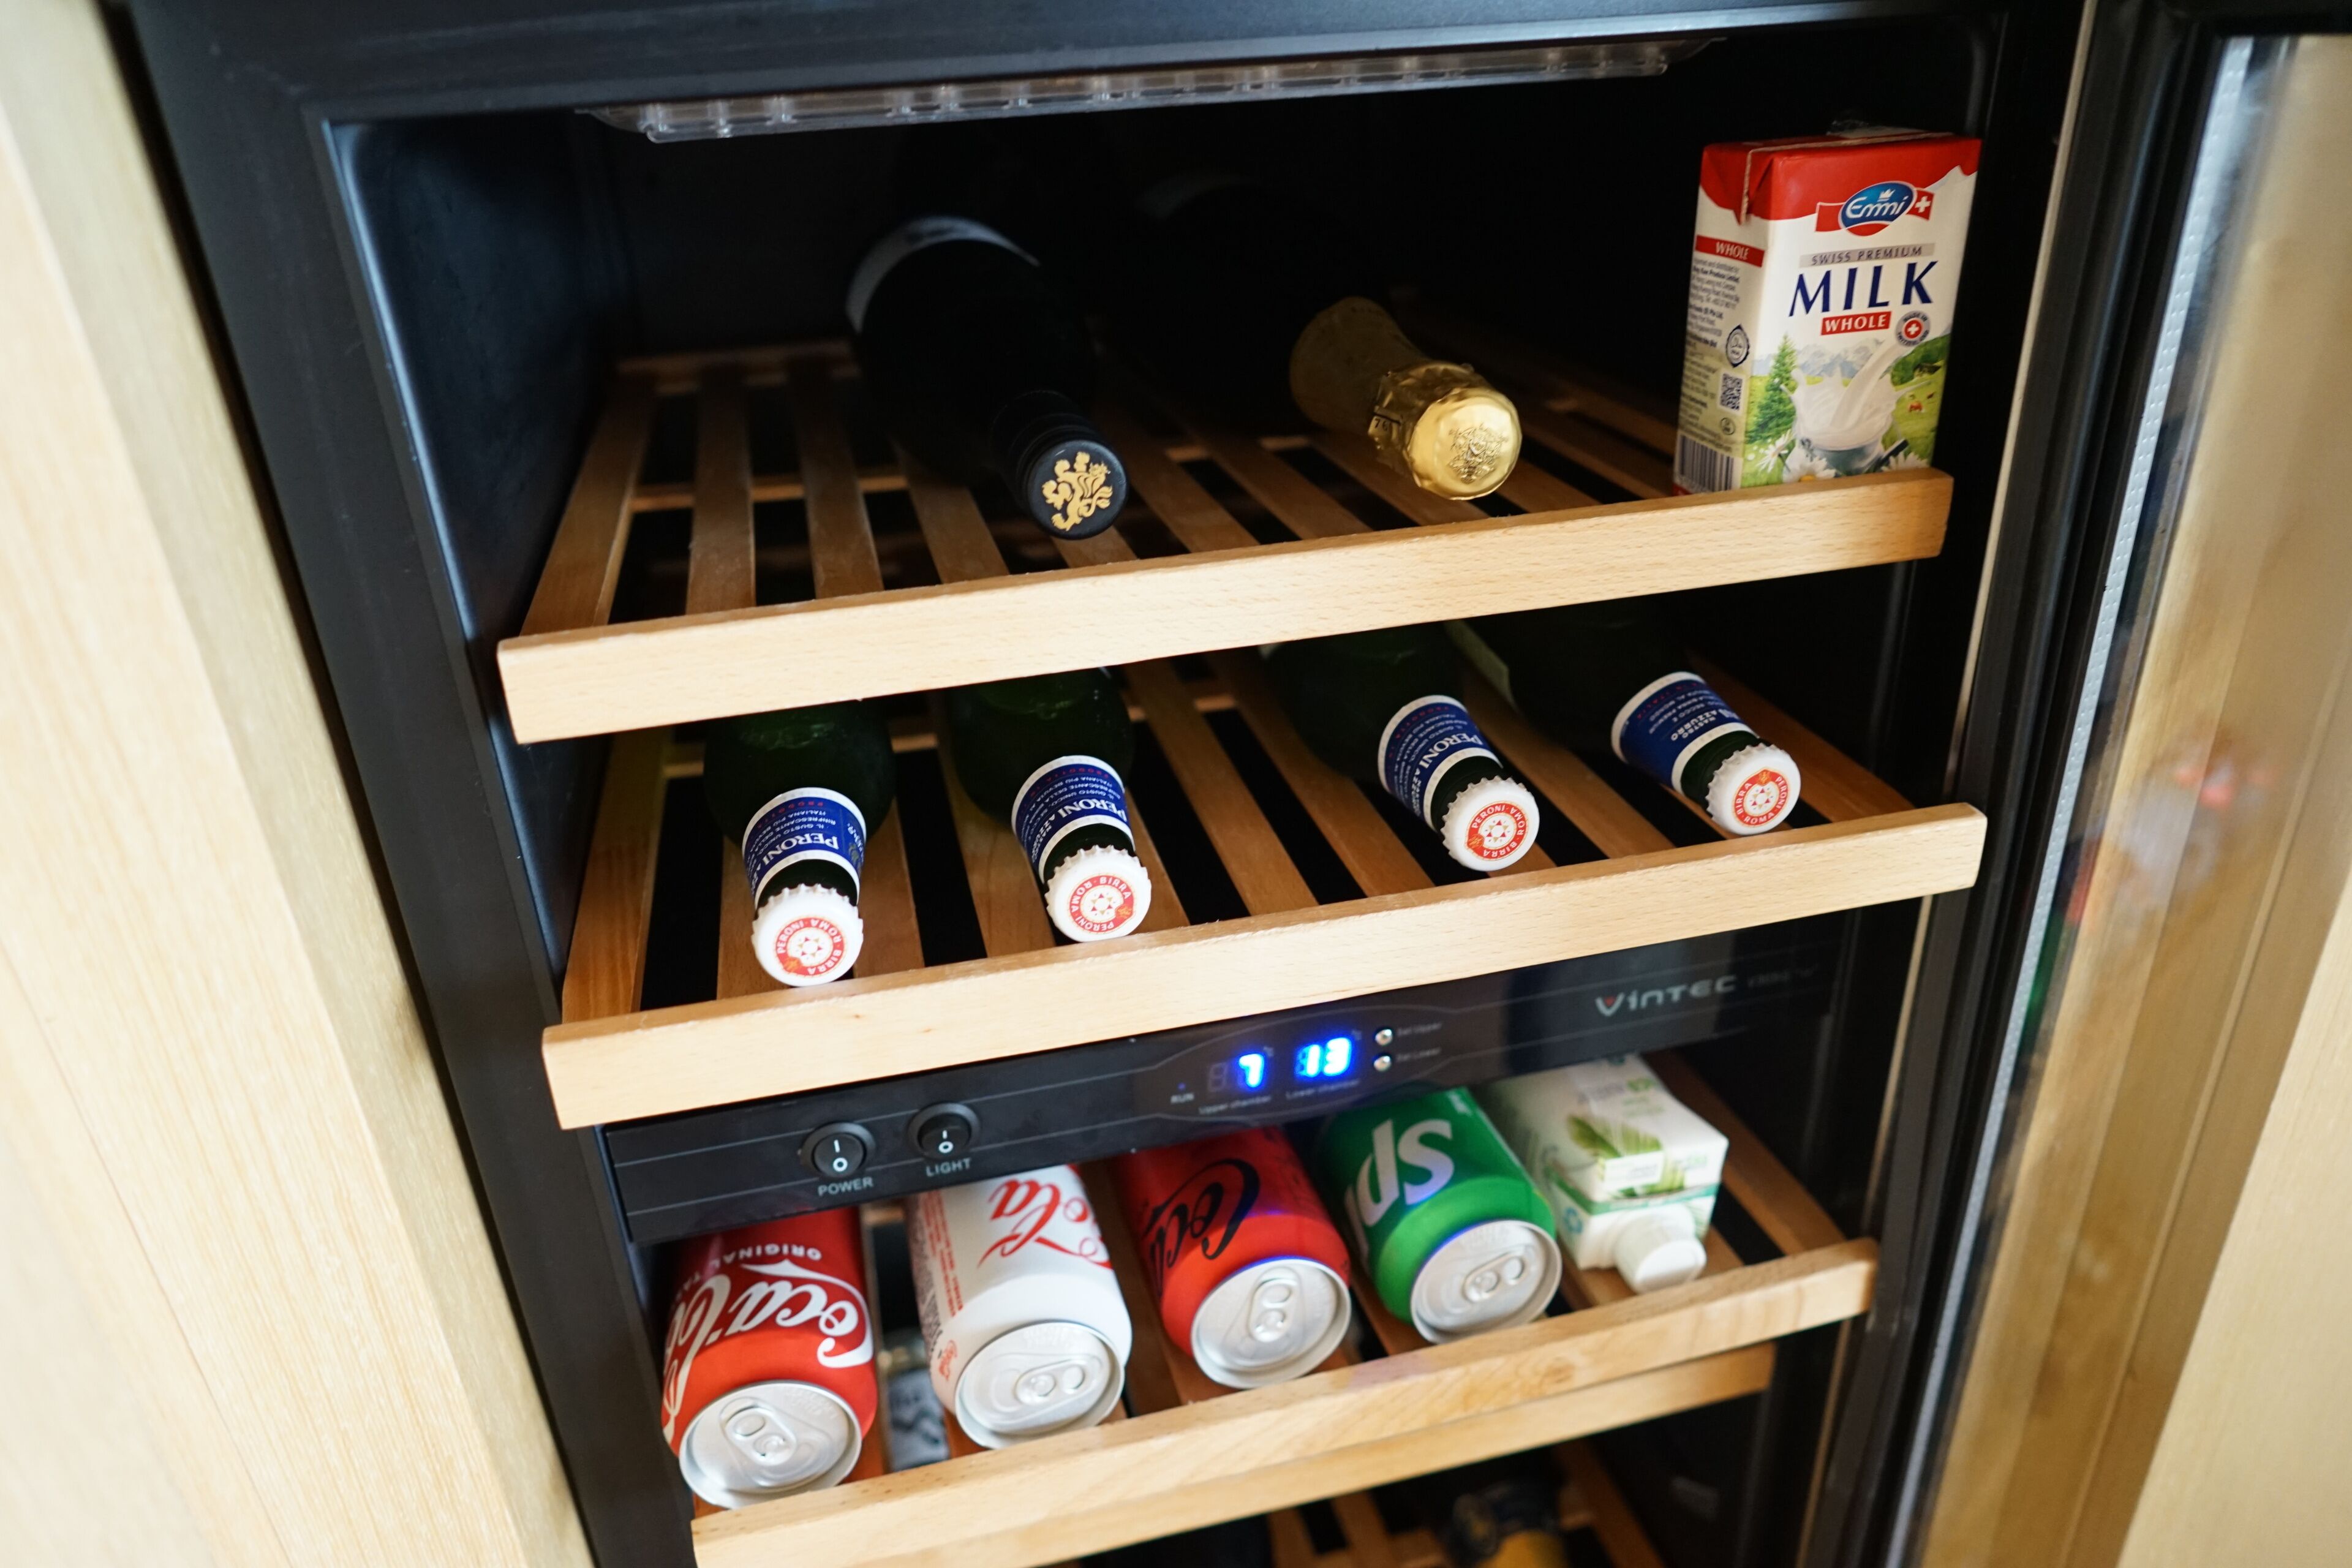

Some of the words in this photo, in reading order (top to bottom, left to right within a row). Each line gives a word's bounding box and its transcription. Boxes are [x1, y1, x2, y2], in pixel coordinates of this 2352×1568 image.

[1846, 194, 1909, 221] Emmi
[1716, 241, 1749, 260] WHOLE
[1811, 251, 1852, 266] SWISS
[1857, 246, 1923, 262] PREMIUM
[1789, 260, 1939, 317] MILK
[1825, 314, 1888, 334] WHOLE
[1669, 709, 1717, 741] AZZURRO
[1681, 715, 1716, 739] NASTRO
[1419, 733, 1484, 769] PERONI
[1736, 782, 1752, 815] BIRRA
[1775, 775, 1789, 810] PERONI
[1058, 798, 1128, 823] PERONI
[1472, 804, 1506, 829] PERONI
[1509, 807, 1526, 836] ROMA
[1744, 811, 1775, 824] ROMA
[762, 832, 839, 866] PERONI
[1483, 842, 1518, 858] BIRRA
[1070, 880, 1093, 912] ROMA
[1099, 876, 1131, 900] BIRRA
[777, 920, 805, 954] PERONI
[810, 919, 843, 945] ROMA
[1077, 917, 1115, 932] PERONI
[807, 949, 842, 976] BIRRA
[1238, 1053, 1265, 1088] 7
[925, 1158, 972, 1177] LIGHT
[818, 1177, 873, 1196] POWER
[712, 1243, 823, 1270] ORIGINAL
[662, 1259, 874, 1444] Coca-Co
